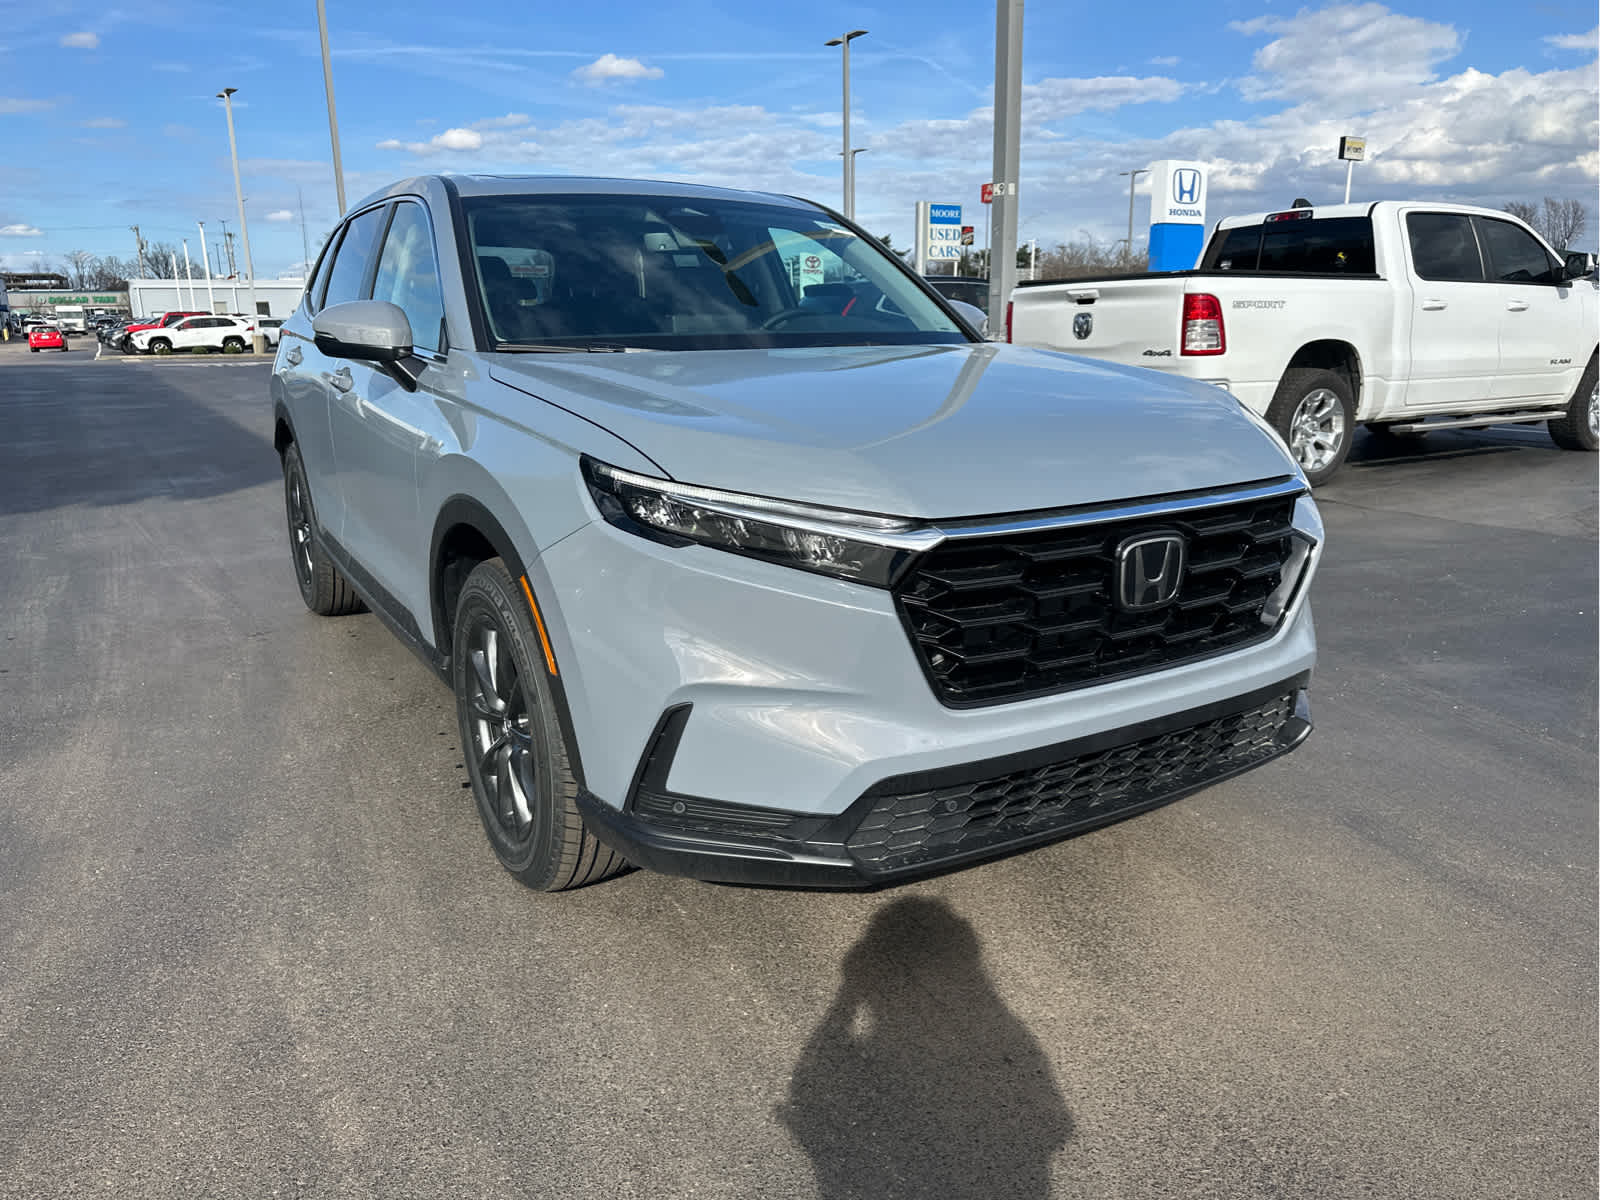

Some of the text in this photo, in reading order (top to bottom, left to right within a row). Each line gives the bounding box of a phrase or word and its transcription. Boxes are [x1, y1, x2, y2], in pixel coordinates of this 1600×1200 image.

[931, 208, 961, 218] MOORE
[1168, 208, 1202, 217] HONDA
[929, 227, 961, 241] USED
[928, 245, 961, 258] CARS
[48, 295, 117, 305] DOLLAR TREE
[1232, 299, 1287, 309] SPORT
